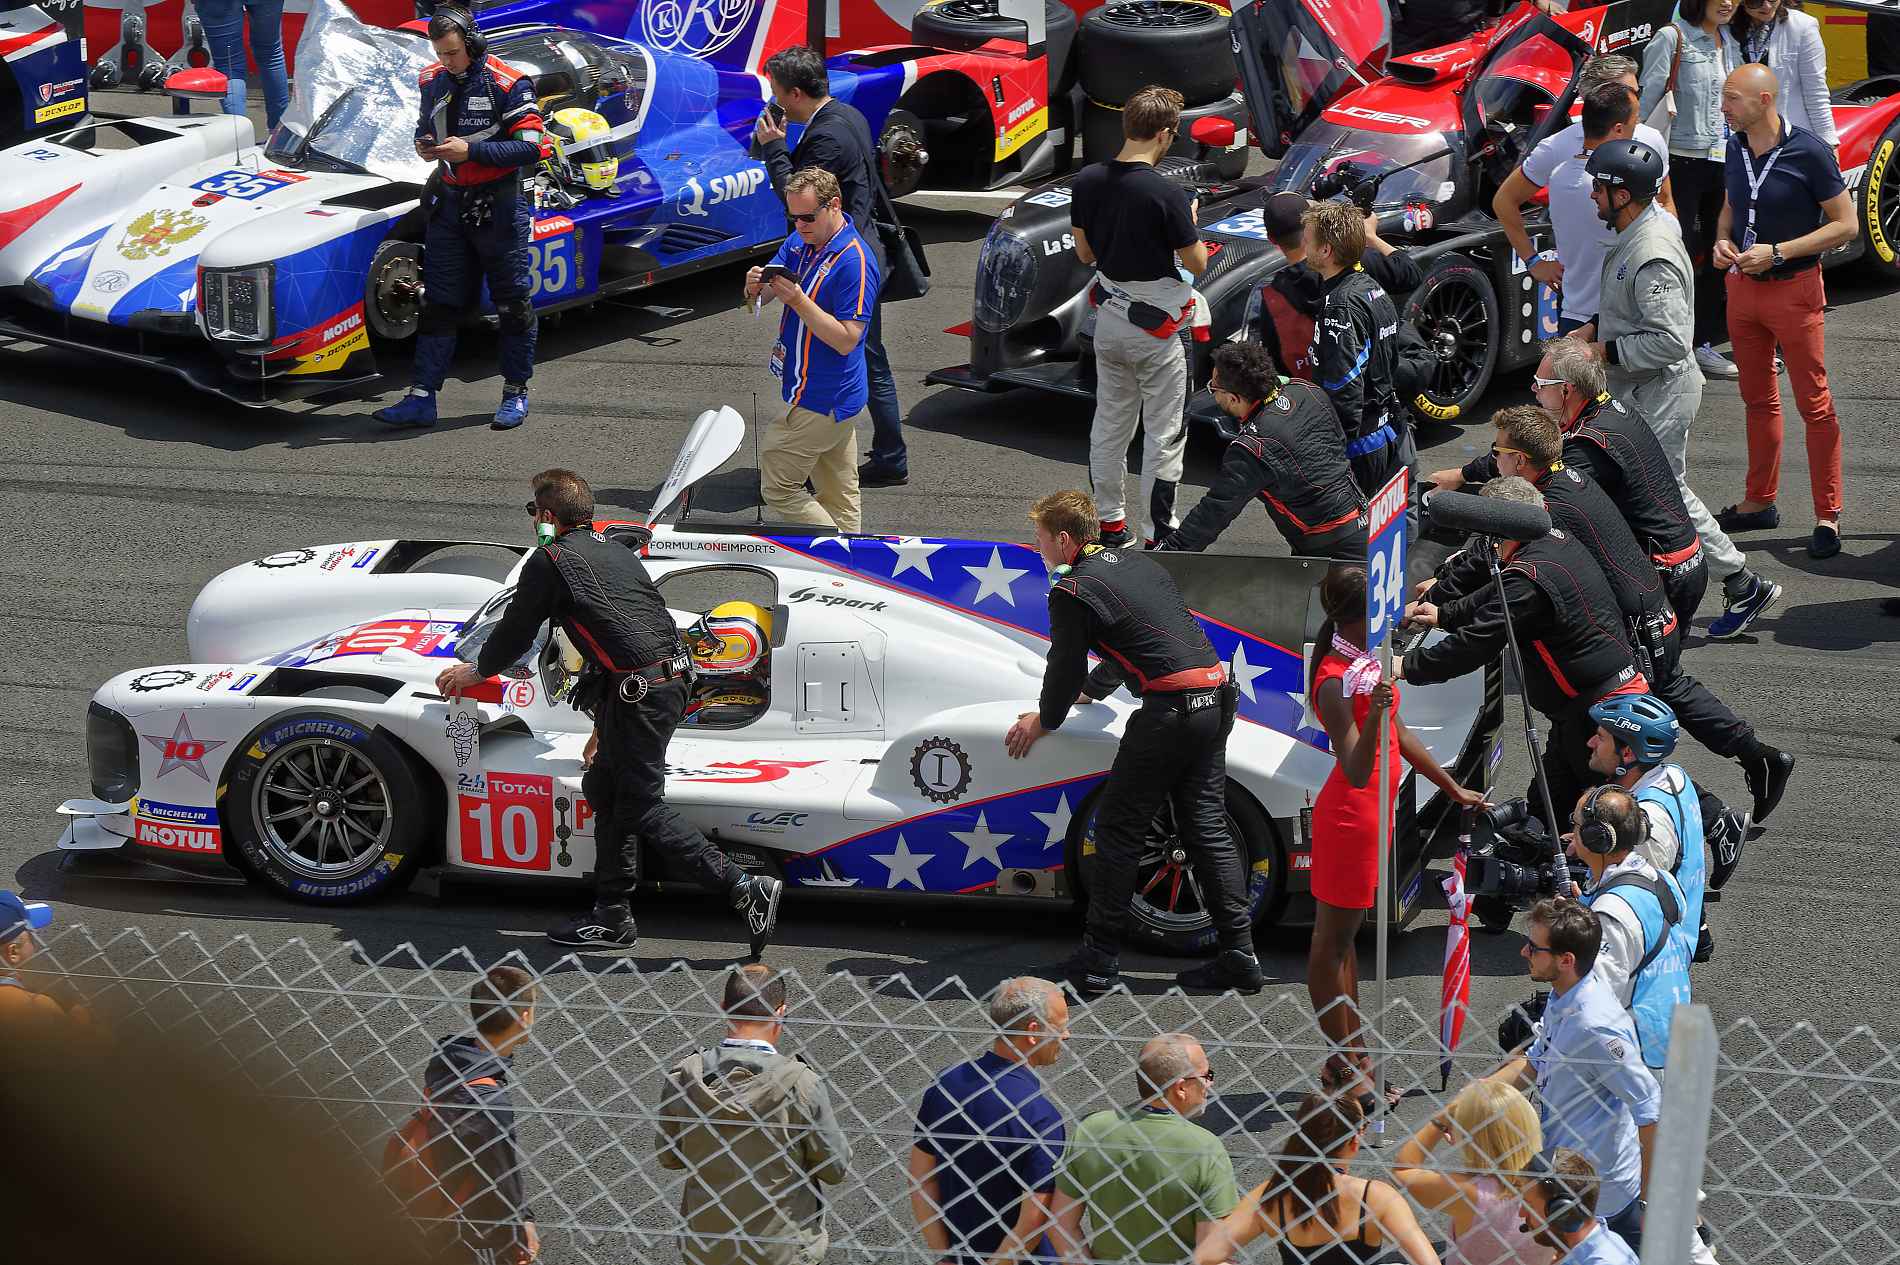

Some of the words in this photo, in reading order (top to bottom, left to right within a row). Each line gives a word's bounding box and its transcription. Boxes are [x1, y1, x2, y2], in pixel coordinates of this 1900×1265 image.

[44, 102, 81, 117] DUNLOP
[458, 118, 490, 126] RACING
[24, 149, 60, 160] P2
[201, 173, 280, 197] 35
[709, 168, 765, 204] SMP
[1869, 148, 1887, 245] DUNLOP
[536, 219, 573, 234] TOTAL
[1042, 239, 1061, 256] La
[528, 238, 567, 297] 35
[323, 313, 361, 342] MOTUL
[326, 333, 364, 357] DUNLOP
[1370, 475, 1406, 537] MOTUL
[650, 541, 776, 554] FORMULAONEIMPORTS
[1370, 530, 1403, 634] 34
[817, 595, 888, 611] spark
[347, 624, 416, 648] 10
[516, 686, 527, 703] E
[275, 722, 357, 743] MICHELIN
[163, 740, 205, 760] 10
[490, 780, 549, 795] TOTAL
[153, 807, 207, 819] MICHELIN
[748, 812, 808, 826] WEC
[139, 823, 216, 850] MOTUL
[469, 803, 538, 863] 10
[298, 872, 378, 896] MICHELIN
